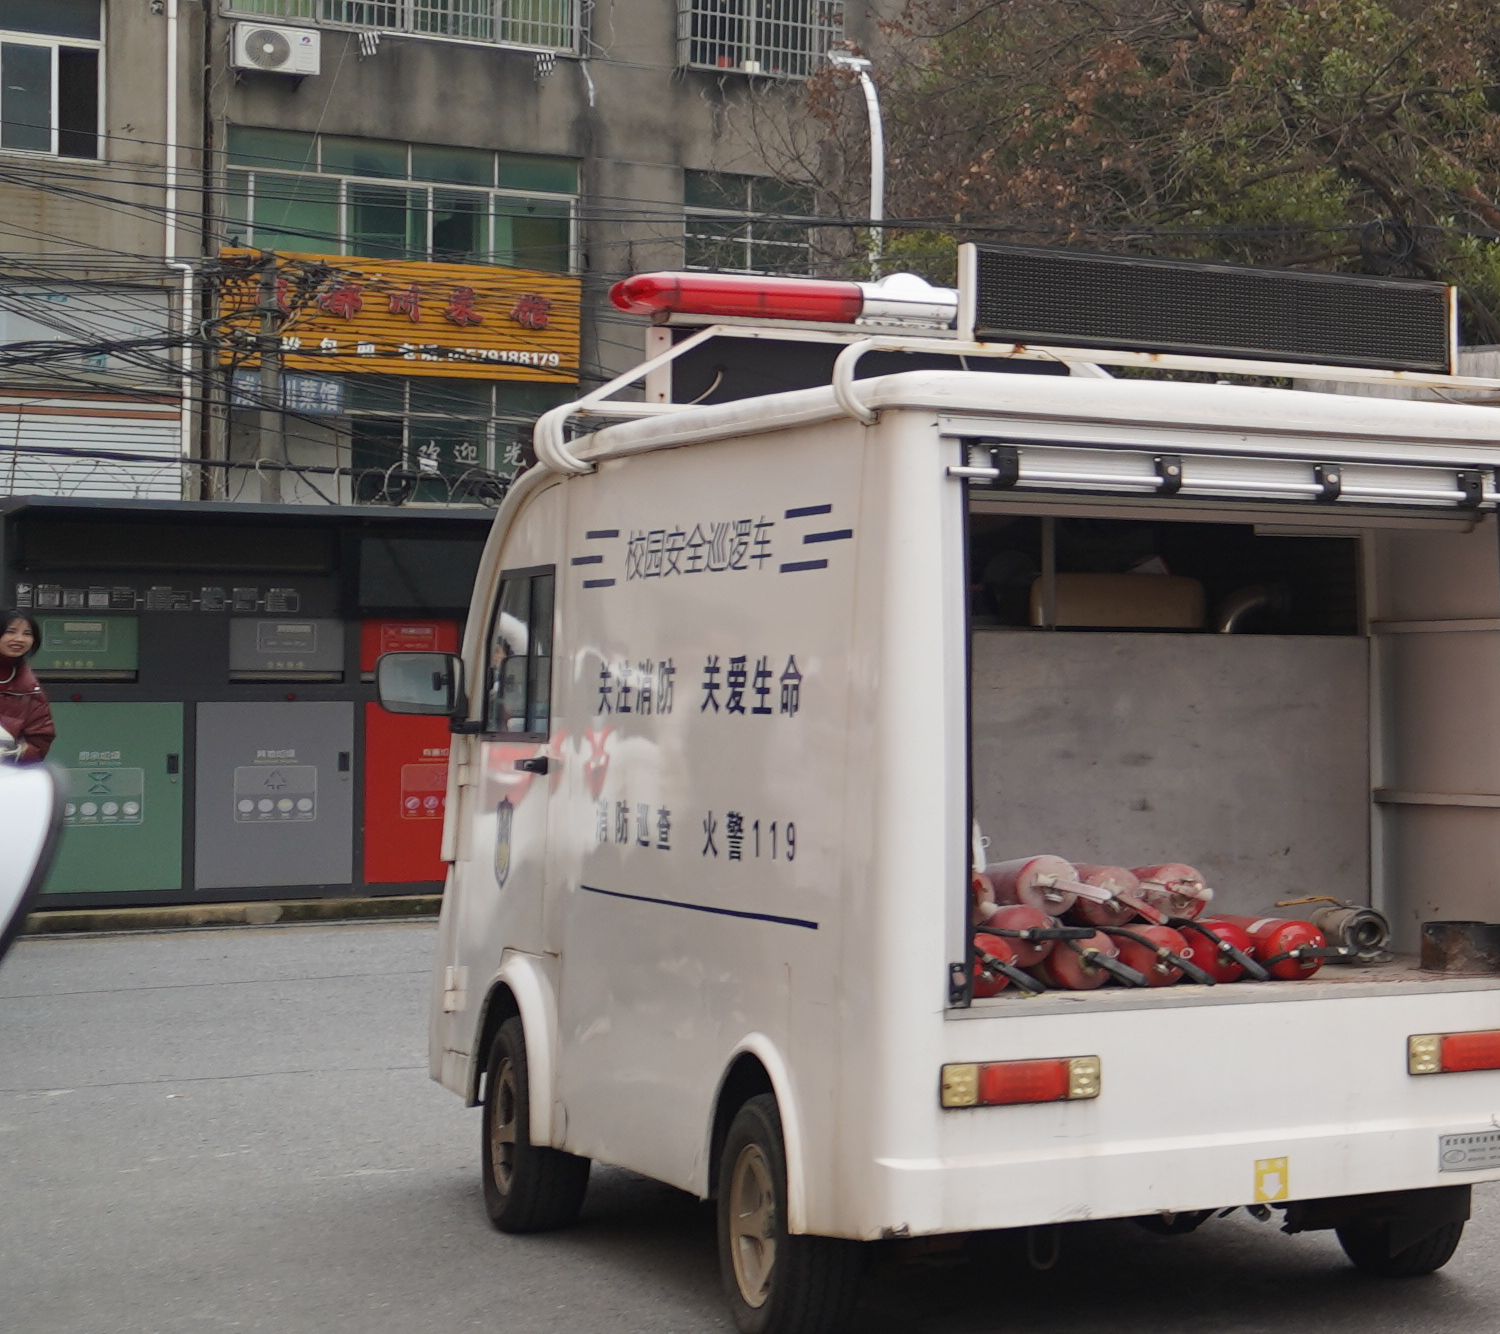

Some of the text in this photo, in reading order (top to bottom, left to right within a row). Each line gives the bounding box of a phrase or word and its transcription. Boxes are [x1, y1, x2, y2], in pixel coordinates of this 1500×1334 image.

[625, 515, 776, 582] 校园安全巡逻车
[598, 653, 803, 718] 关注消防 关爱生命
[596, 796, 797, 862] 消防巡查 火警119
